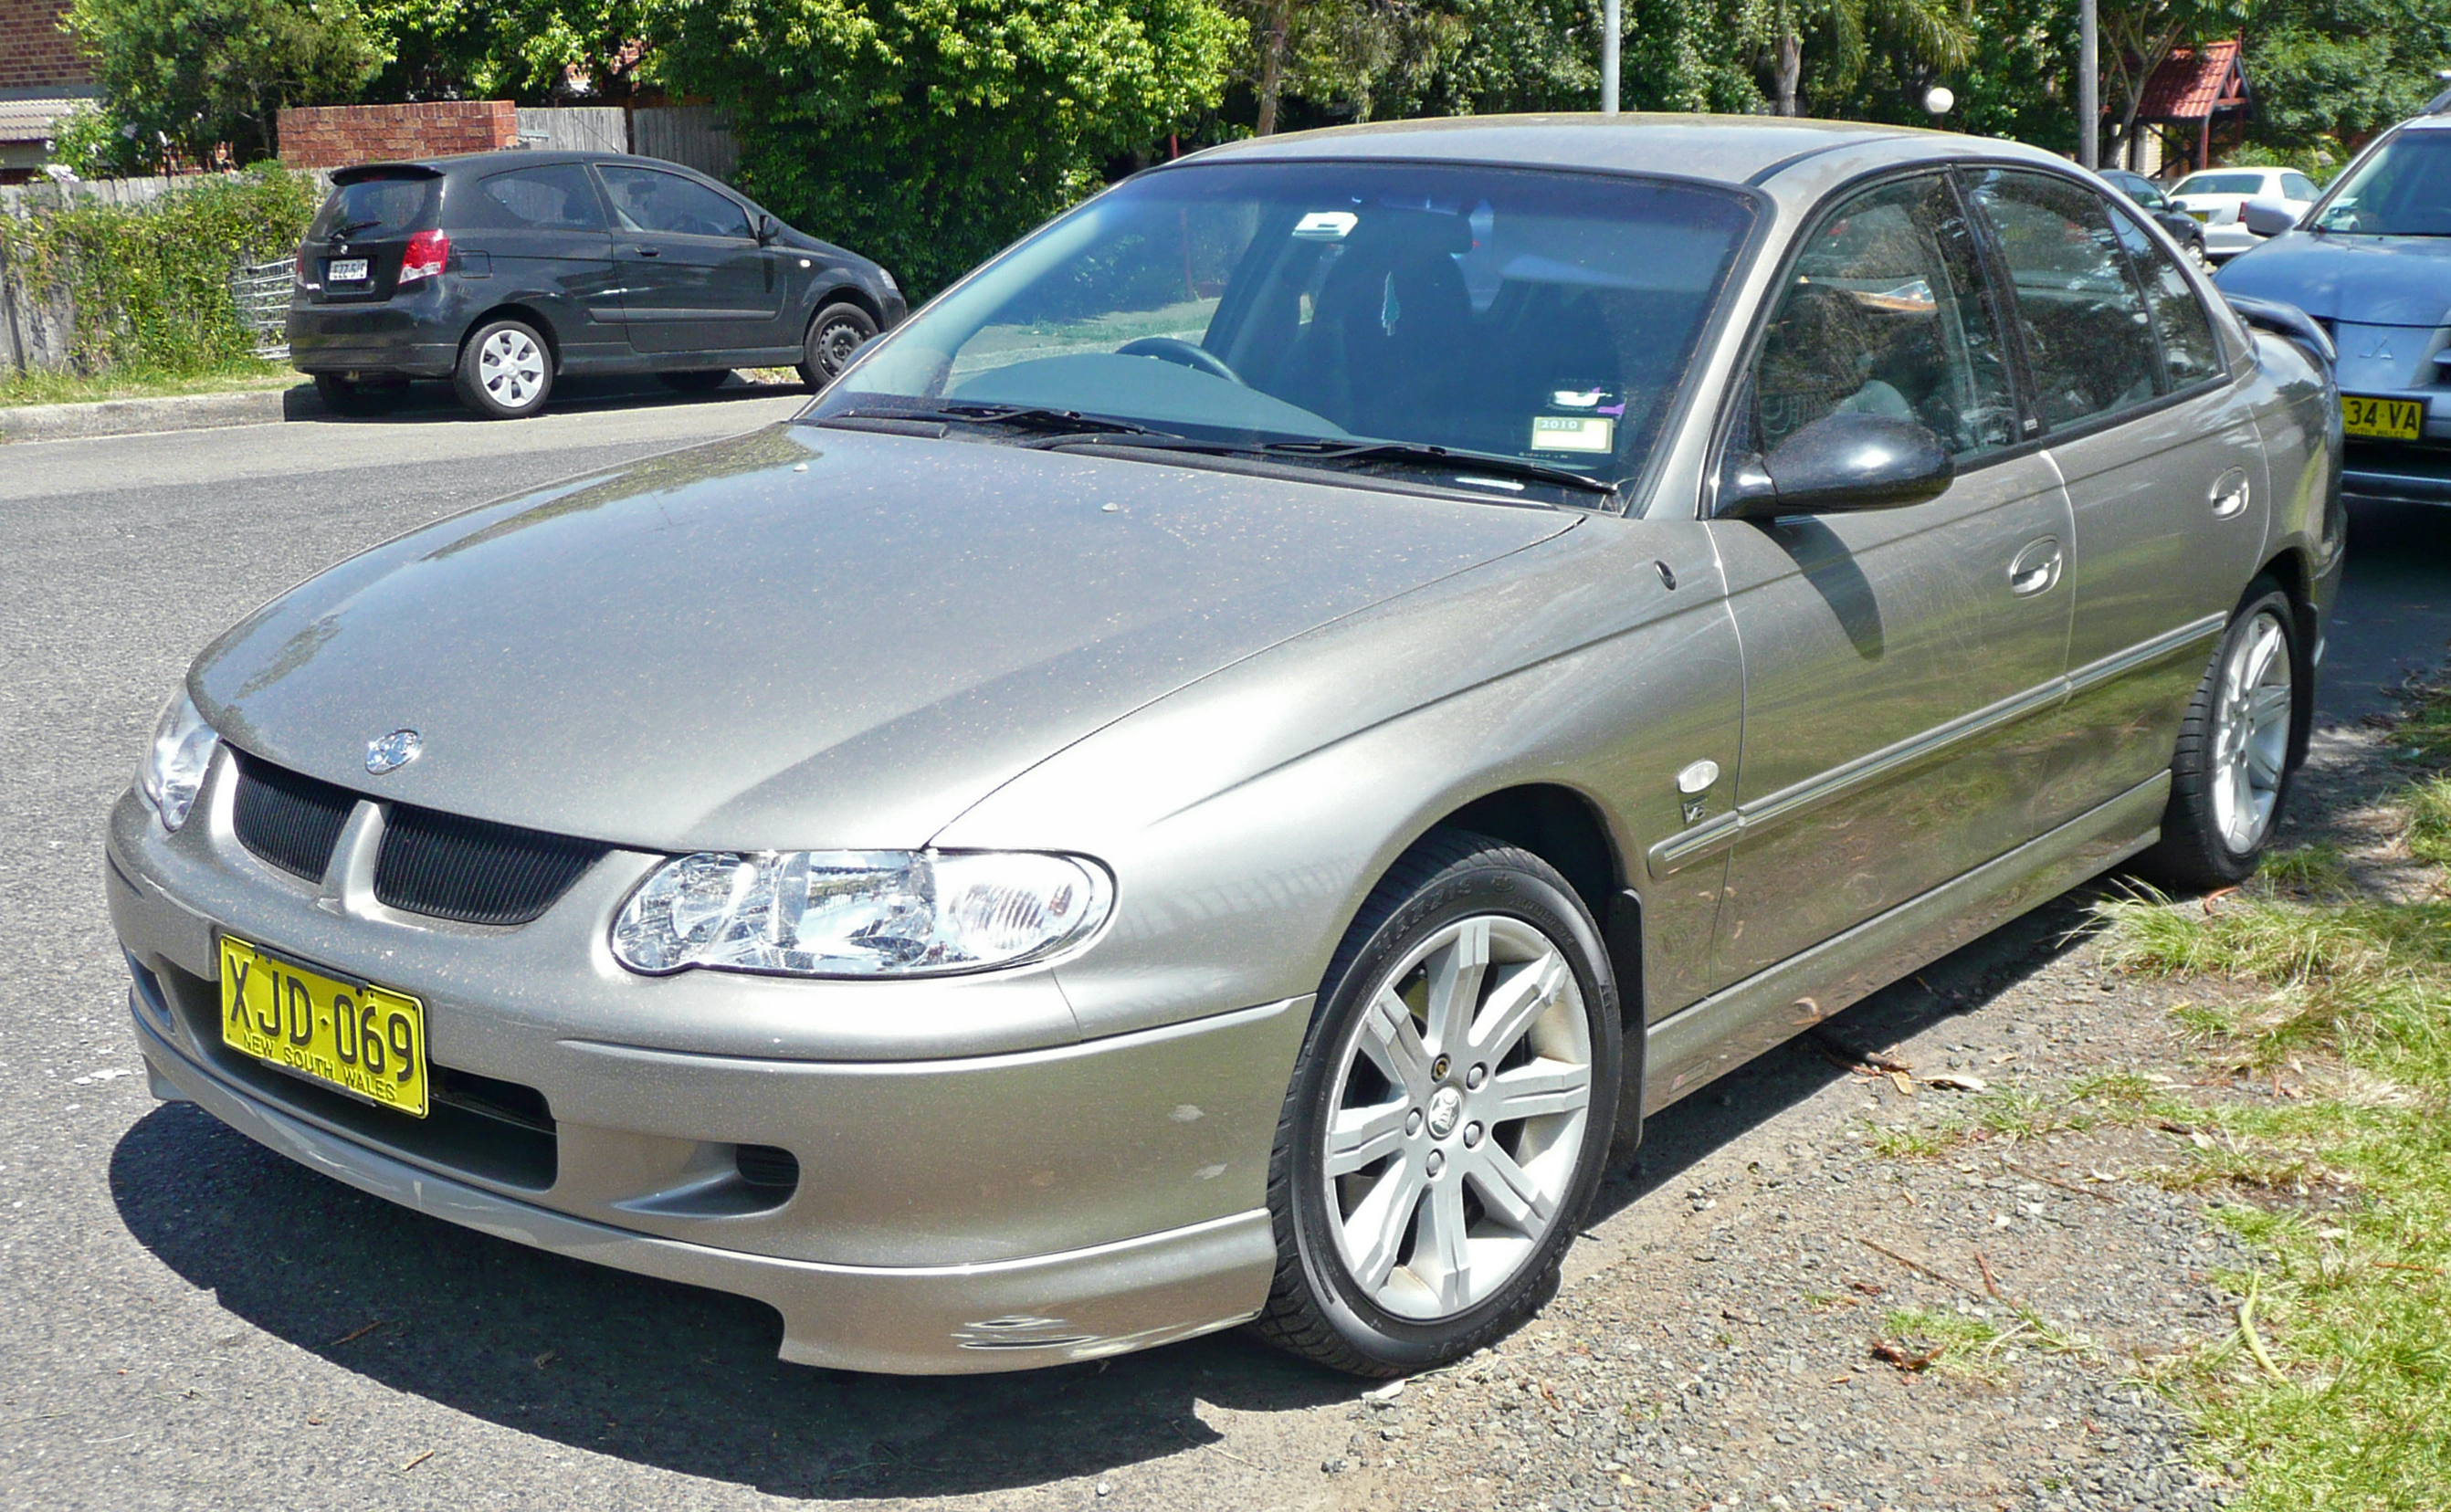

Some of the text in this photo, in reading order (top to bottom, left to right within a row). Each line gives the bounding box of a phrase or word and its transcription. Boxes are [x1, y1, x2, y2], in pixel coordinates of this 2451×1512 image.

[1541, 420, 1577, 429] 2010
[243, 1031, 397, 1102] NEW SOUTH WALES
